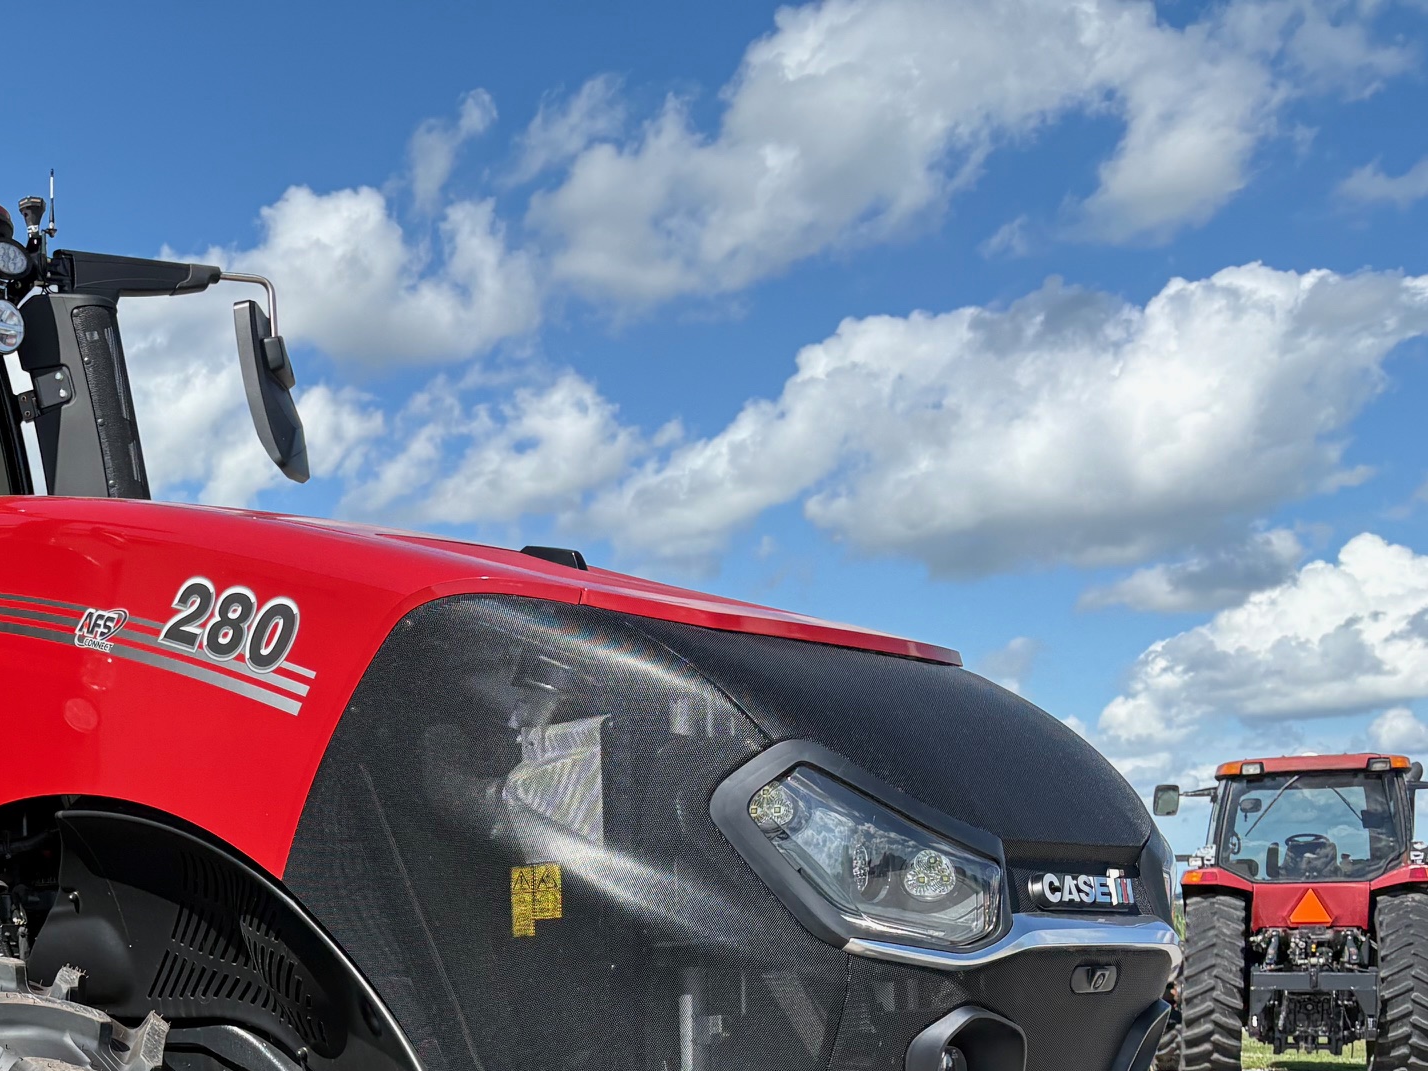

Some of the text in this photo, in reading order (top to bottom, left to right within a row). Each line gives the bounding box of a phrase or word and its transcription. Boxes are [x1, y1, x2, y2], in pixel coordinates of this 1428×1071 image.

[75, 609, 118, 640] AFS
[158, 576, 300, 674] 280
[82, 638, 113, 653] CONNECT
